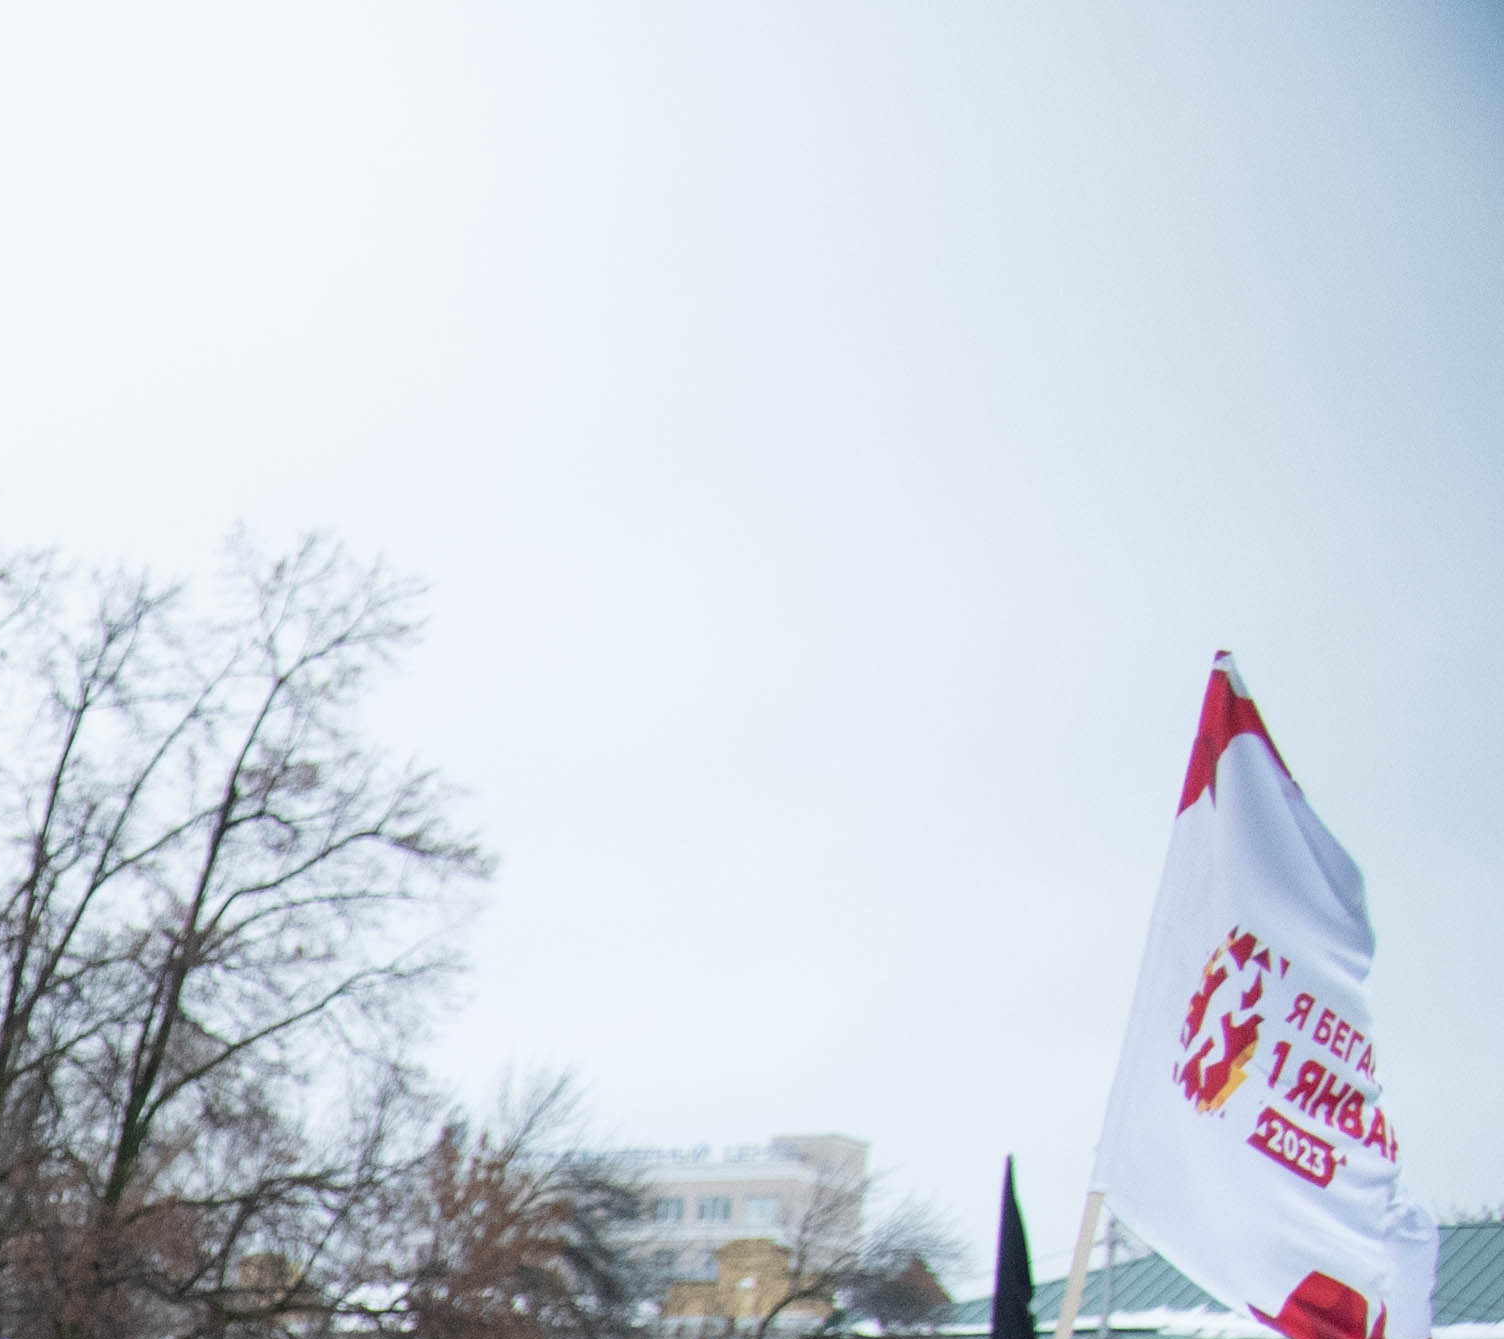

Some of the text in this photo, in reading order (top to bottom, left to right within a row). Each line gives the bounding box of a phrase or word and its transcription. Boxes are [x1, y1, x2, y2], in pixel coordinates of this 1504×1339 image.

[1285, 993, 1316, 1031] Я
[1268, 1041, 1292, 1088] 1
[1264, 1118, 1325, 1178] 2023
